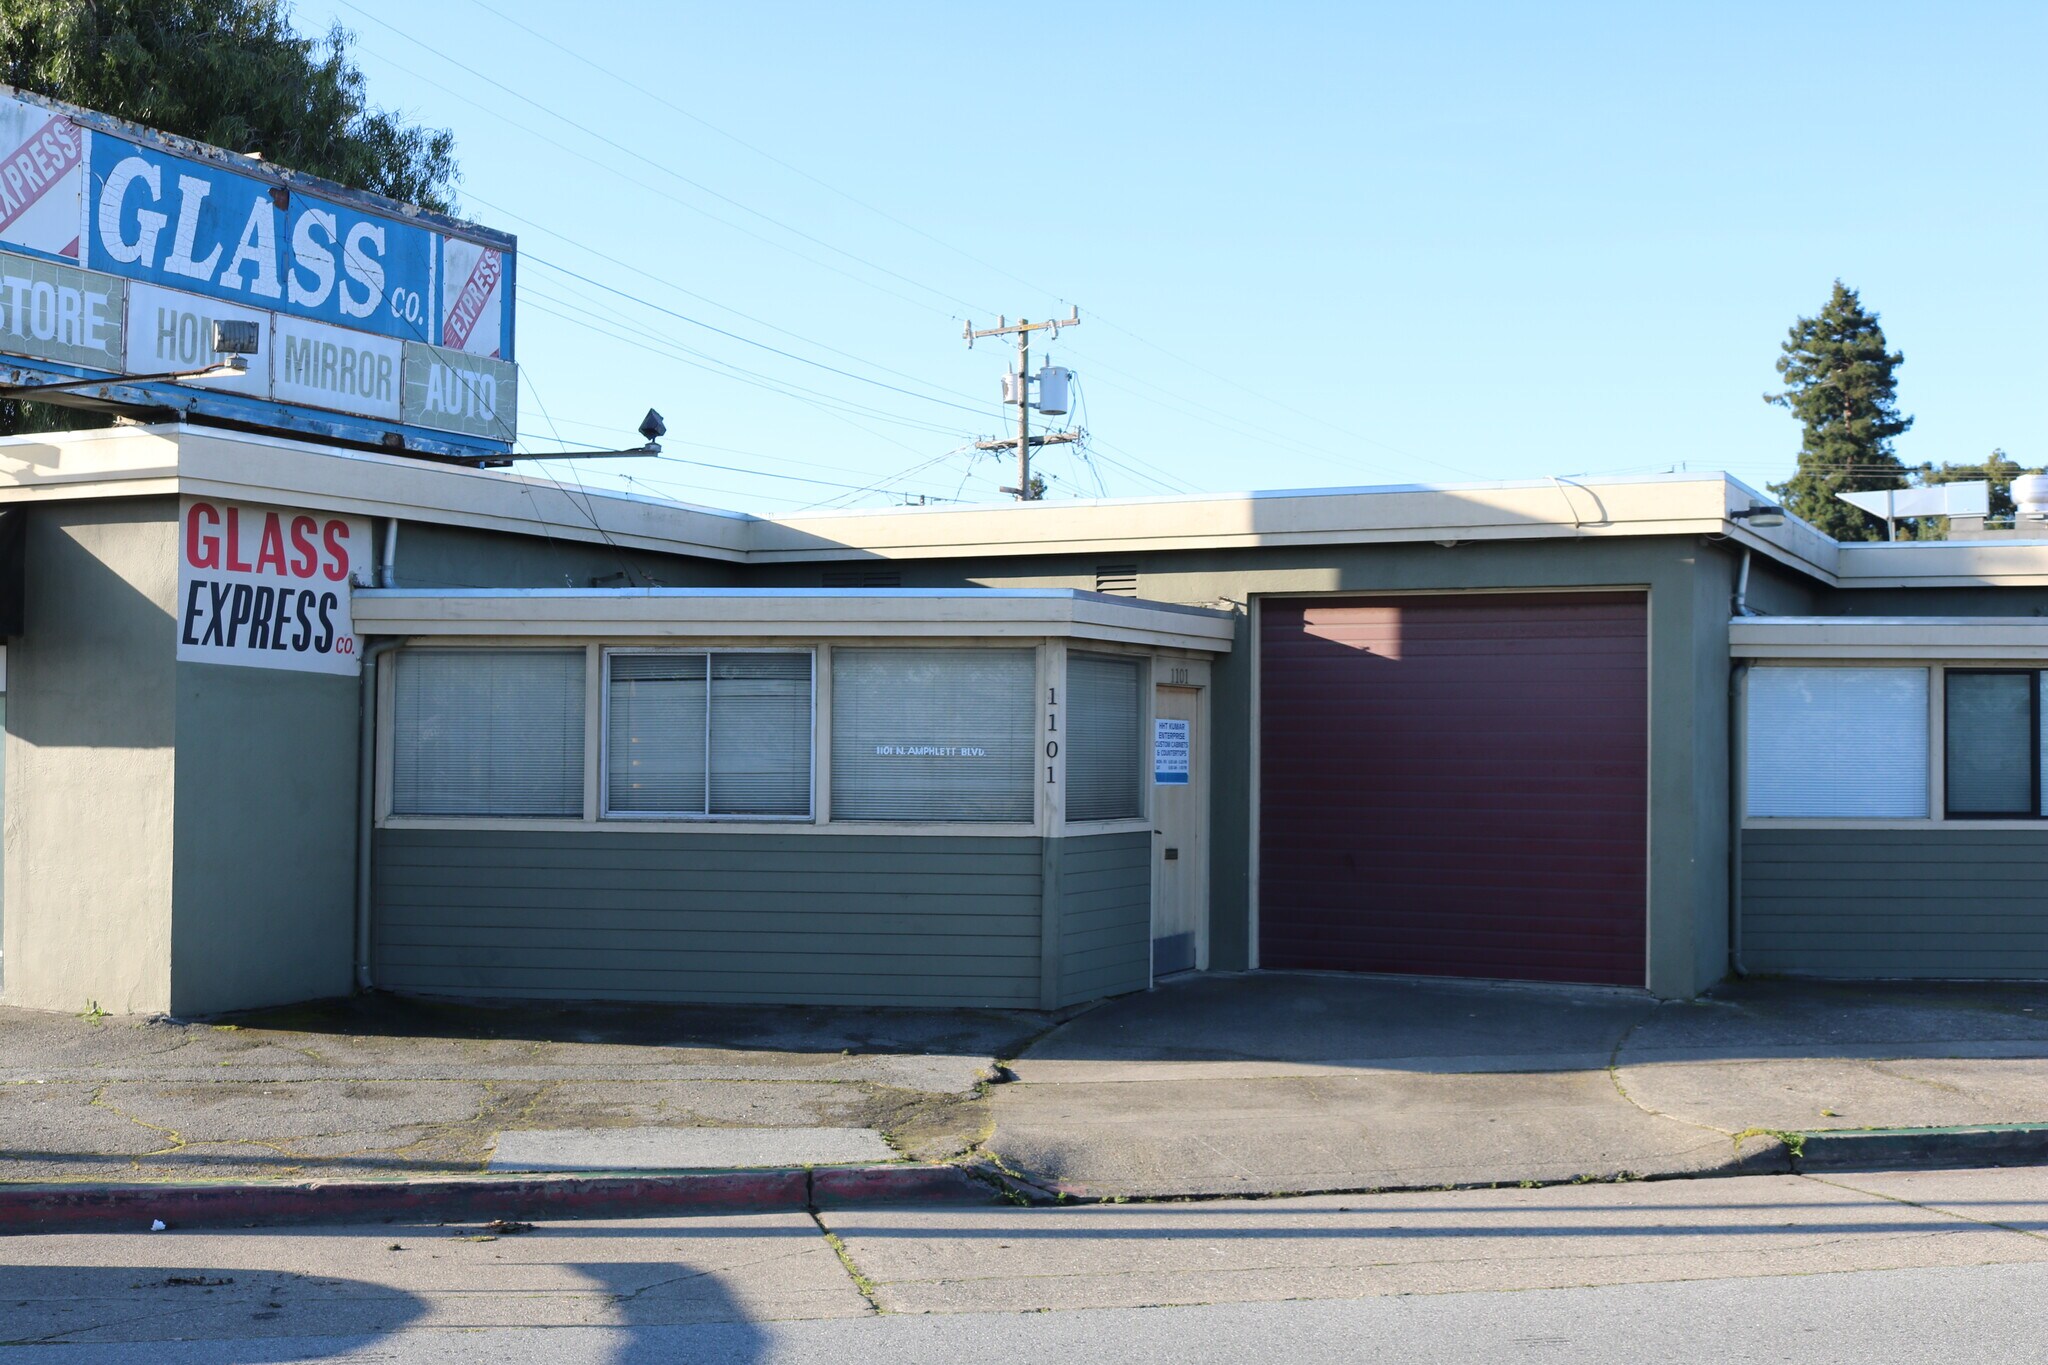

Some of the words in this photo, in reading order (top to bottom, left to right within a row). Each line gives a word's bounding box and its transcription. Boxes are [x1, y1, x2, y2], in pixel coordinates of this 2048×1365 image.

[0, 122, 77, 224] XPRESS
[98, 156, 386, 319] GLASS
[391, 287, 424, 326] CO.
[0, 274, 108, 351] TORE
[451, 250, 500, 341] EXPRESS
[284, 334, 393, 402] MIRROR
[425, 362, 497, 421] AUTO
[186, 502, 350, 582] GLASS
[182, 579, 338, 654] EXPRESS
[335, 636, 355, 655] CO.
[1170, 668, 1189, 685] 1101
[876, 745, 893, 756] 1101
[907, 745, 957, 757] AMPHLETT
[1046, 687, 1059, 784] 1101
[1155, 740, 1171, 748] CUSTOM
[1171, 741, 1189, 749] CABINETS
[1158, 732, 1186, 740] ENTERPRISE
[1161, 749, 1187, 757] COUNTERTOPS
